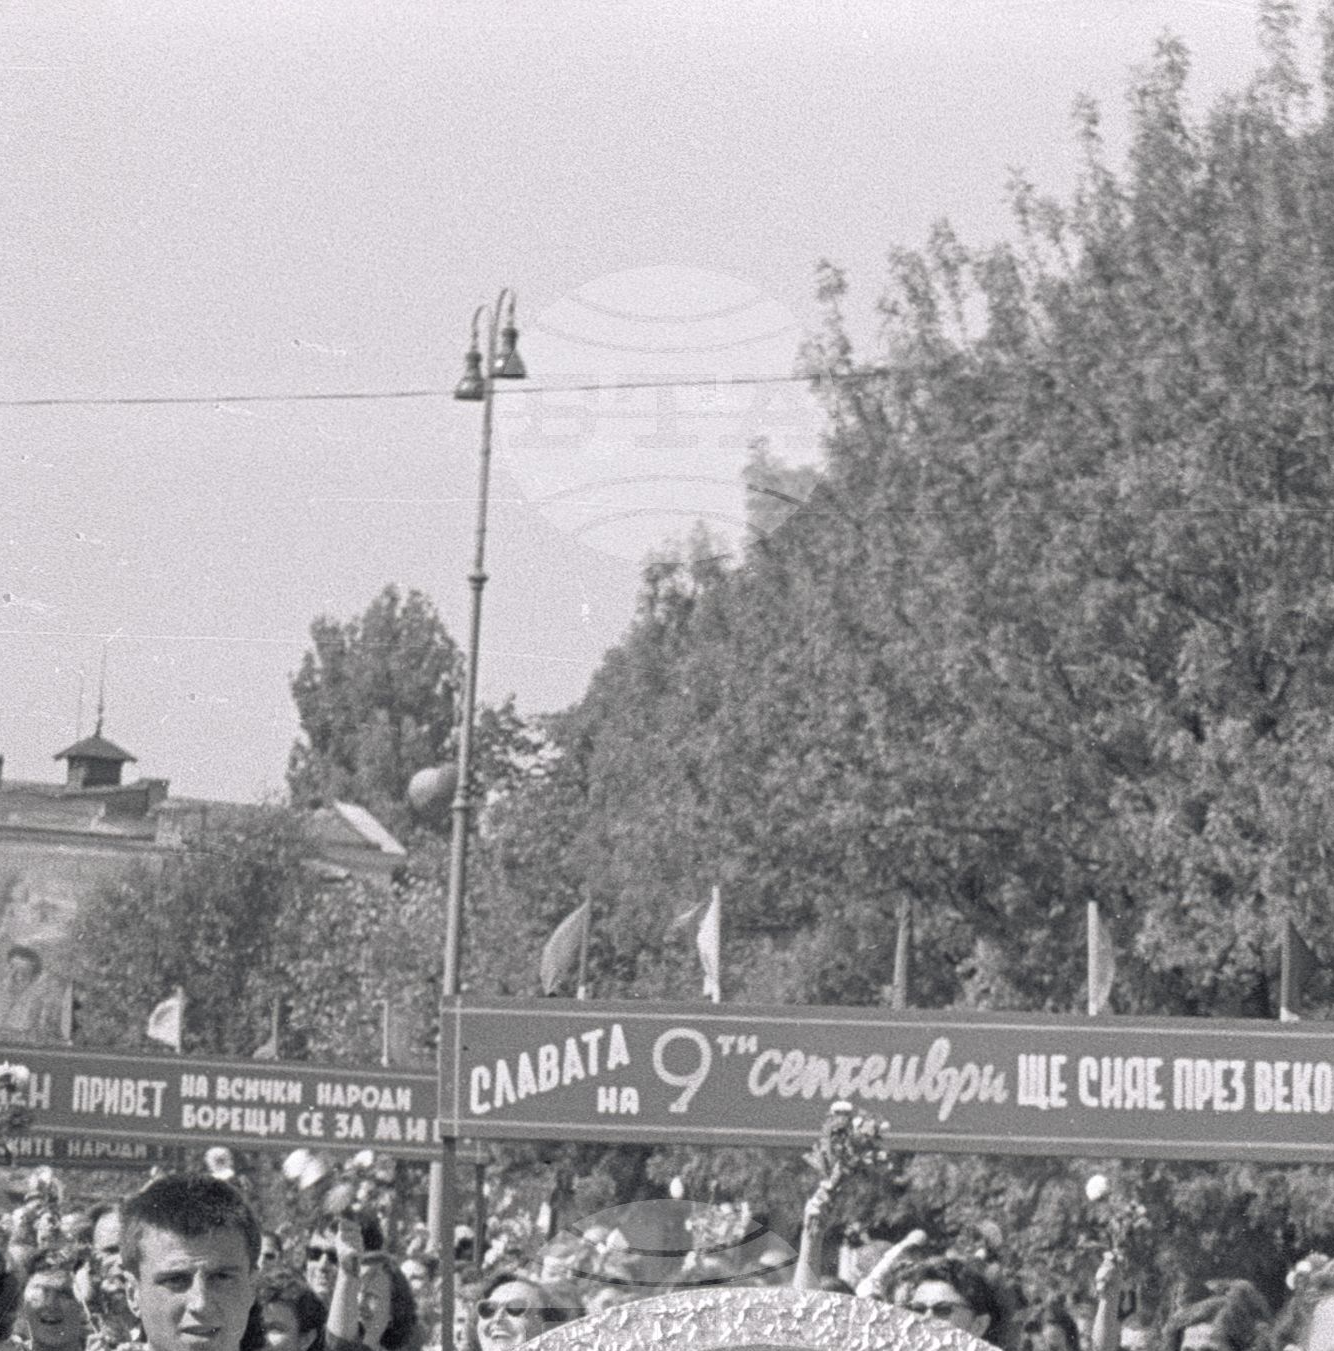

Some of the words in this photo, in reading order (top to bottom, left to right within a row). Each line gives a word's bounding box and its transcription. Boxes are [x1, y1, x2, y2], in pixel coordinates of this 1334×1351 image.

[470, 1023, 630, 1115] СЛАВАТА
[597, 1086, 639, 1115] НА
[1017, 1054, 1068, 1110] ЩЕ
[1078, 1056, 1166, 1111] СИЯЕ
[1173, 1058, 1246, 1112] ПРЕЗ
[72, 1075, 168, 1118] ПРИВЕТ
[180, 1073, 209, 1099] НА
[216, 1075, 303, 1104] ВСИЧКИ
[317, 1081, 412, 1111] НАРОДИ
[181, 1104, 286, 1136] БОРЕЩИ
[296, 1111, 324, 1138] СЕ
[335, 1112, 365, 1139] ЗА
